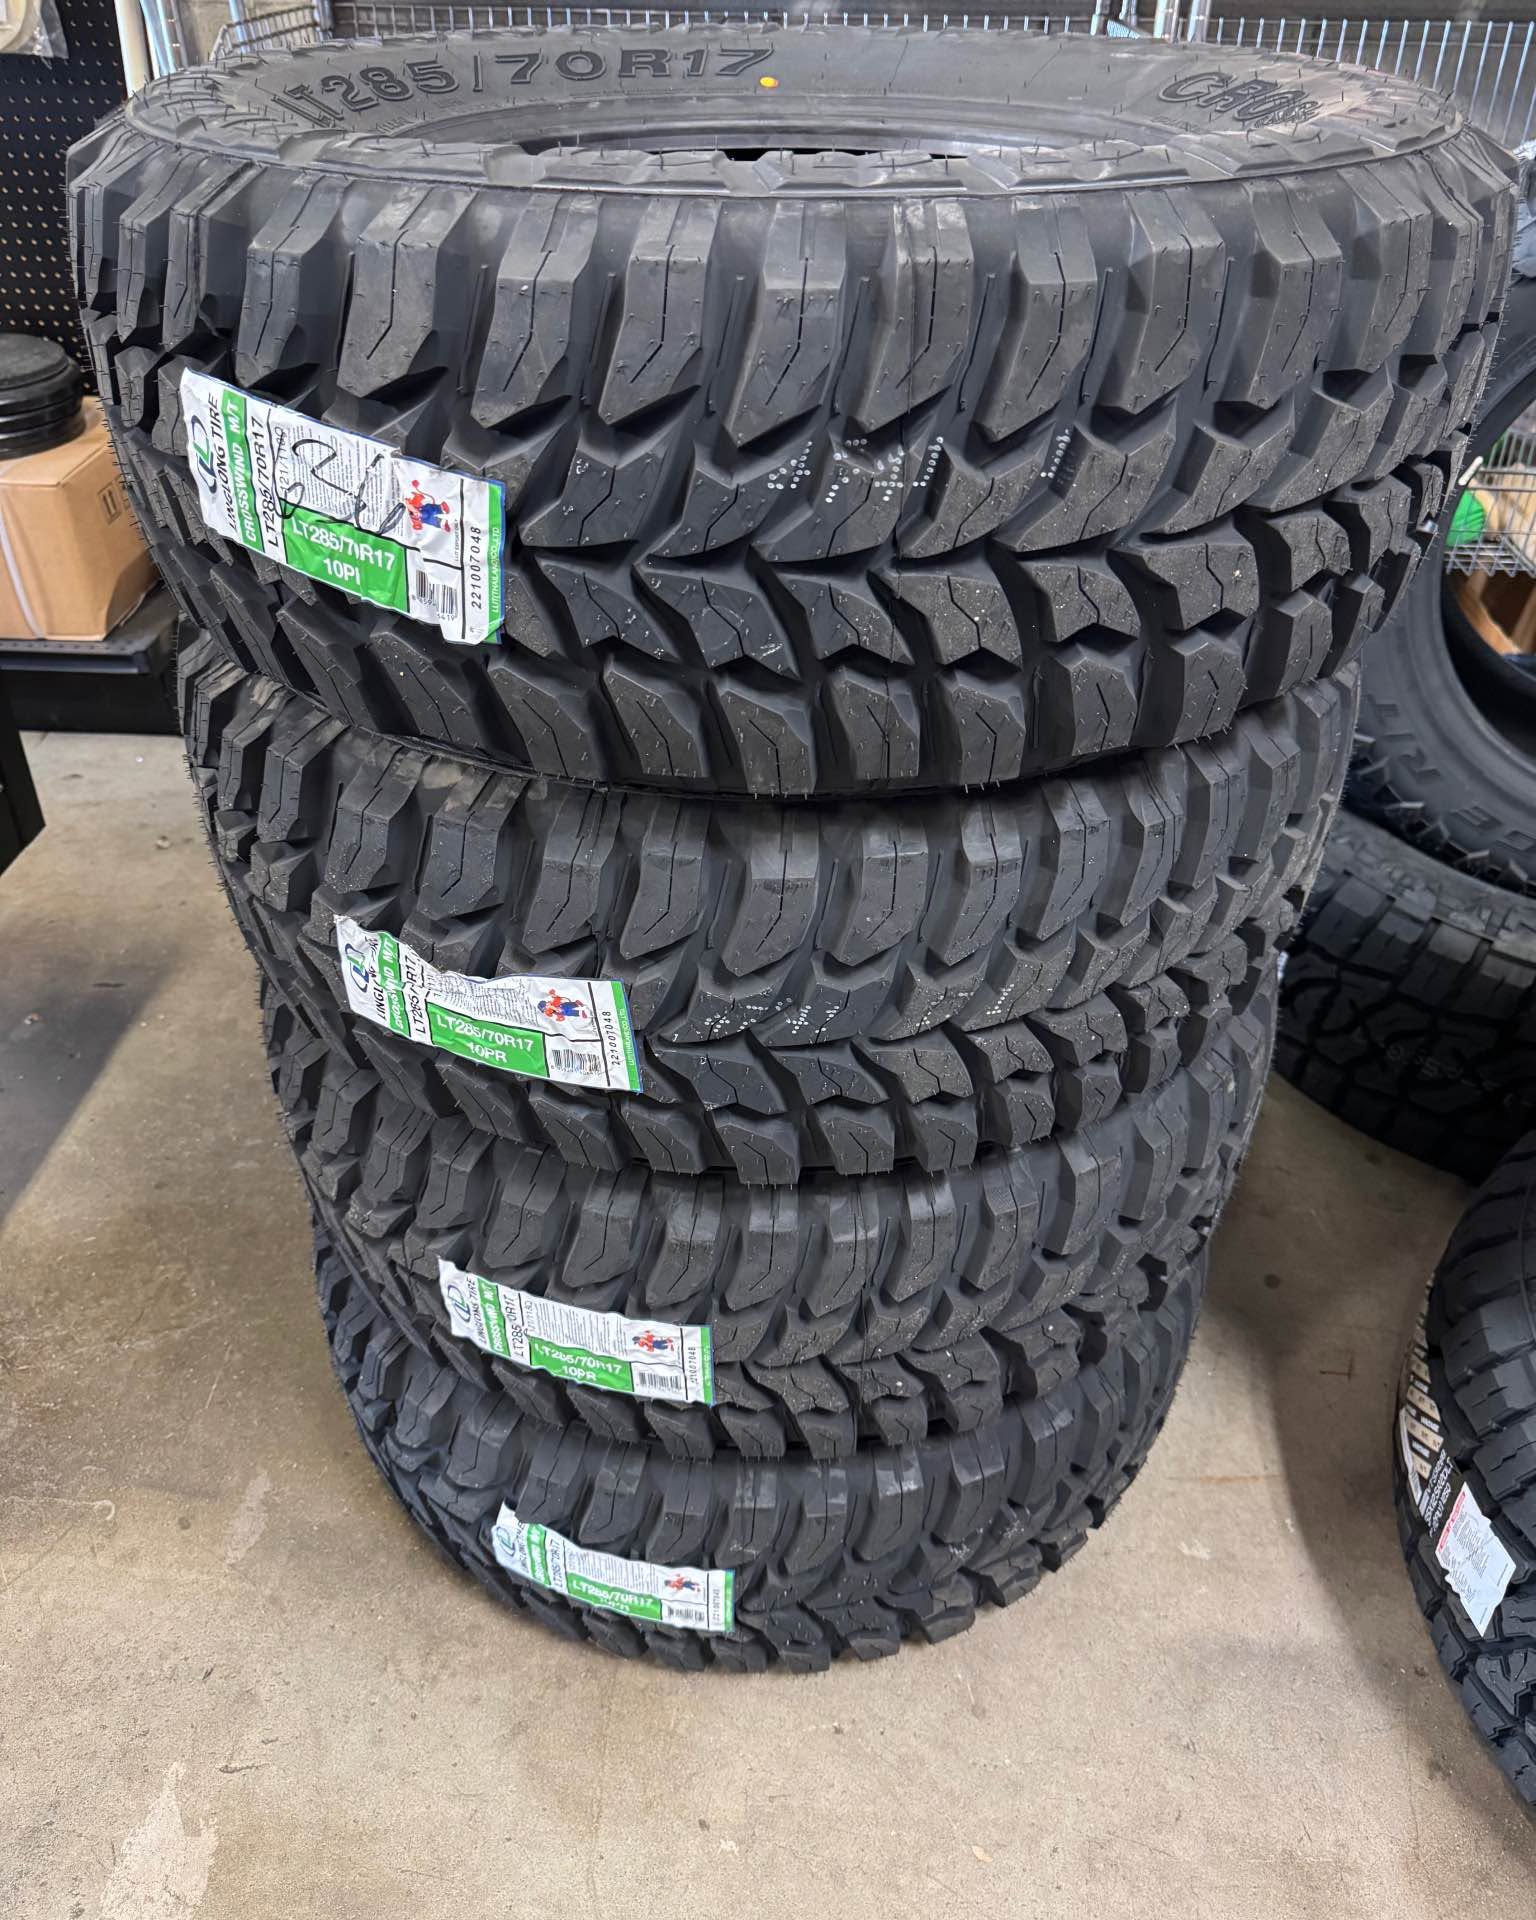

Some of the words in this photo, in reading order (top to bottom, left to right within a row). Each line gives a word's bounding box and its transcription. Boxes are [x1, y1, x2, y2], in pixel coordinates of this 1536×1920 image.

[208, 392, 224, 438] TIRE
[226, 399, 242, 434] M/T
[214, 446, 238, 534] LINGLONG
[231, 443, 257, 542] CROSSWIND
[251, 416, 280, 547] LT285/70R17
[469, 526, 483, 610] 221007048
[466, 1041, 509, 1064] 10PR
[602, 1010, 621, 1067] 221007048
